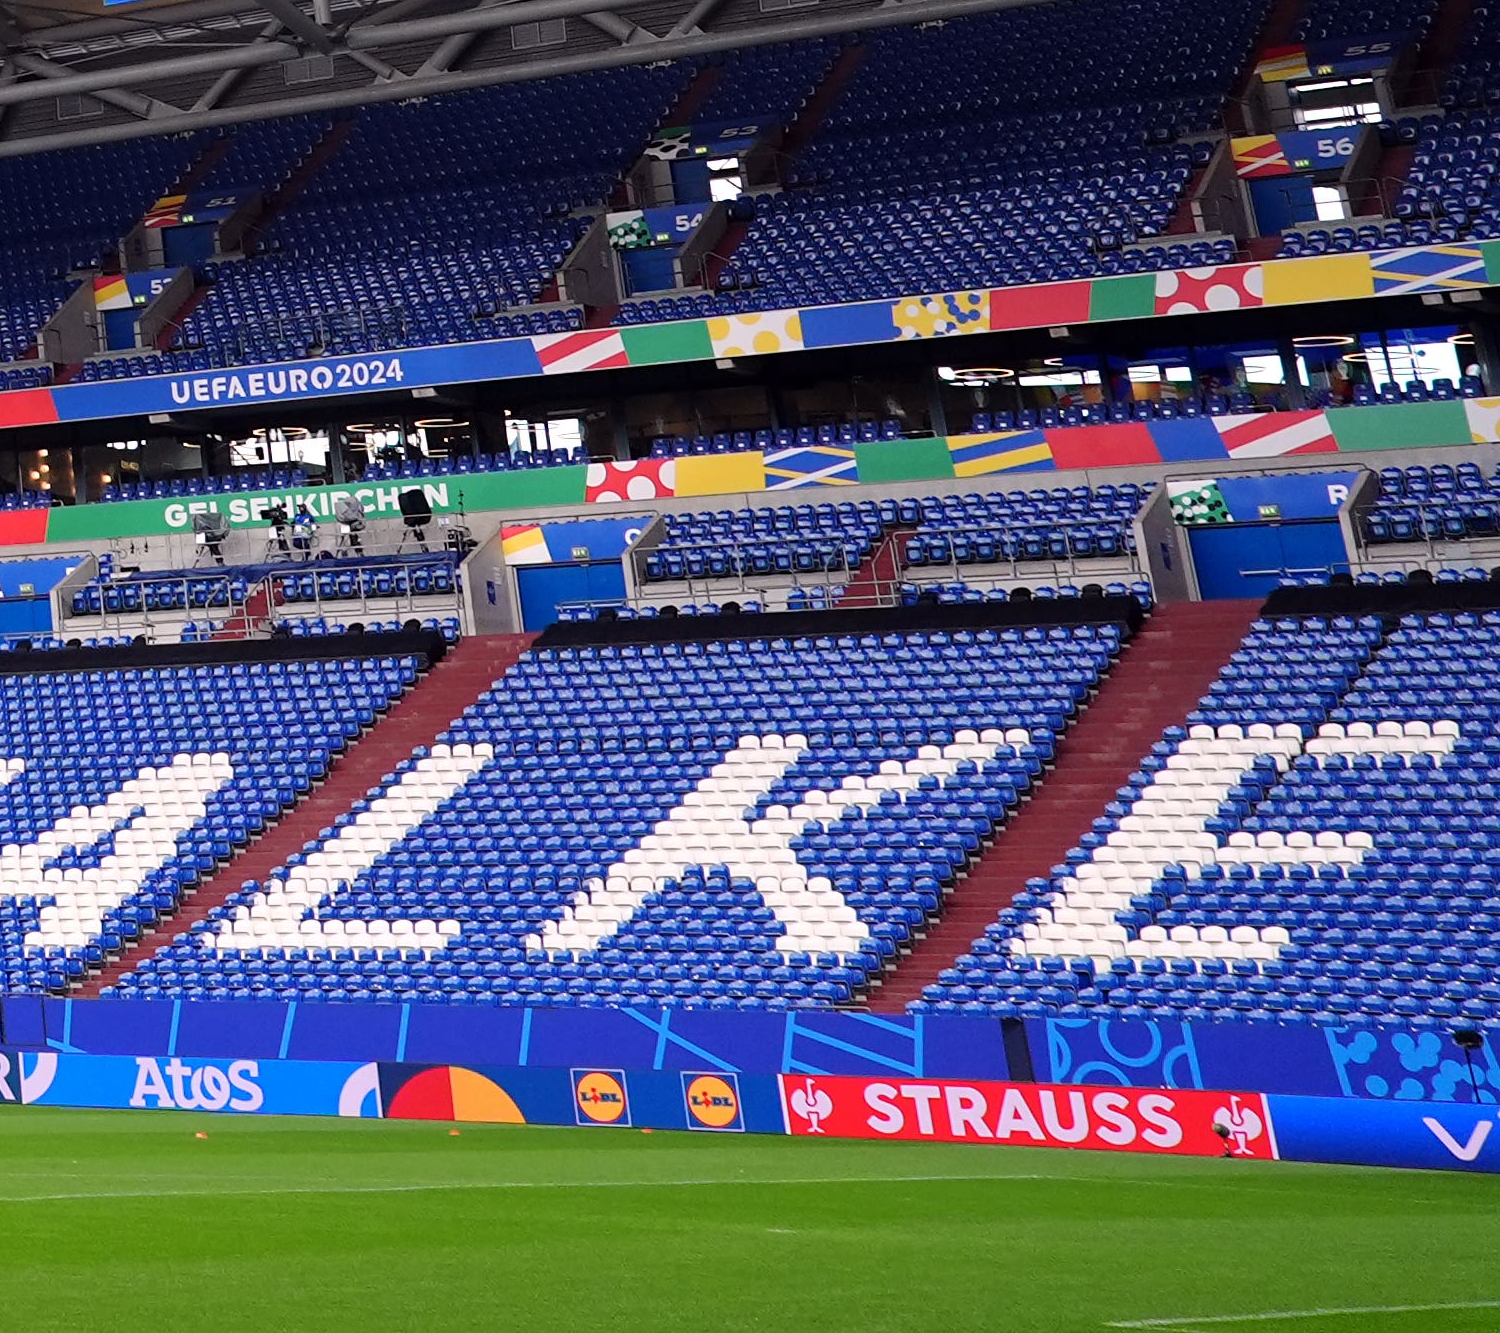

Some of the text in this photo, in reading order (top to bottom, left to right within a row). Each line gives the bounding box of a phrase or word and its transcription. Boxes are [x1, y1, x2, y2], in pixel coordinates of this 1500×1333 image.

[1343, 42, 1392, 57] 55
[1317, 137, 1355, 158] 56
[205, 196, 237, 208] 51
[151, 277, 173, 294] 5
[1327, 483, 1349, 508] R
[862, 1082, 1183, 1148] STRAUSS
[1422, 1112, 1500, 1161] v
